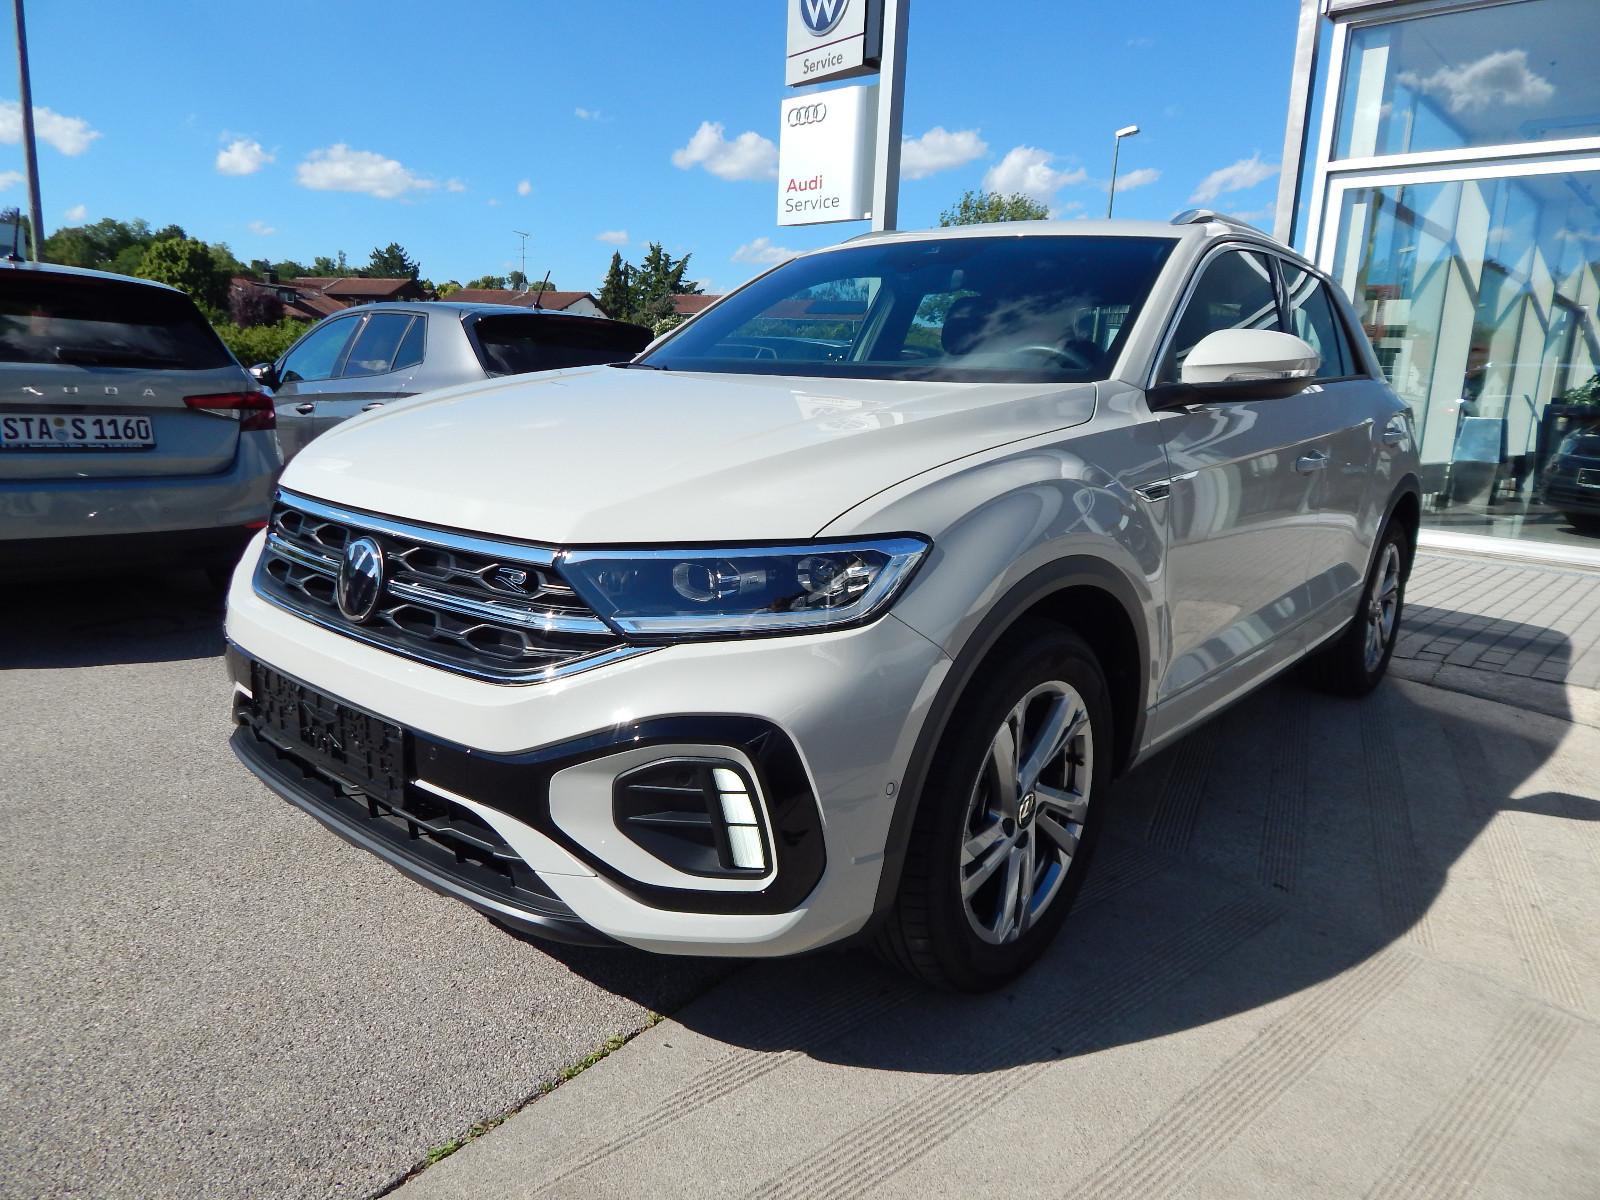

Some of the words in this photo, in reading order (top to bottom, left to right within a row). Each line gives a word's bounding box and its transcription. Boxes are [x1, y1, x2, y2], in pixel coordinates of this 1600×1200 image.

[803, 53, 843, 74] Service
[786, 175, 823, 193] Audi
[785, 195, 840, 213] Service
[3, 417, 53, 440] STA
[71, 418, 87, 440] S
[92, 419, 151, 440] 1160
